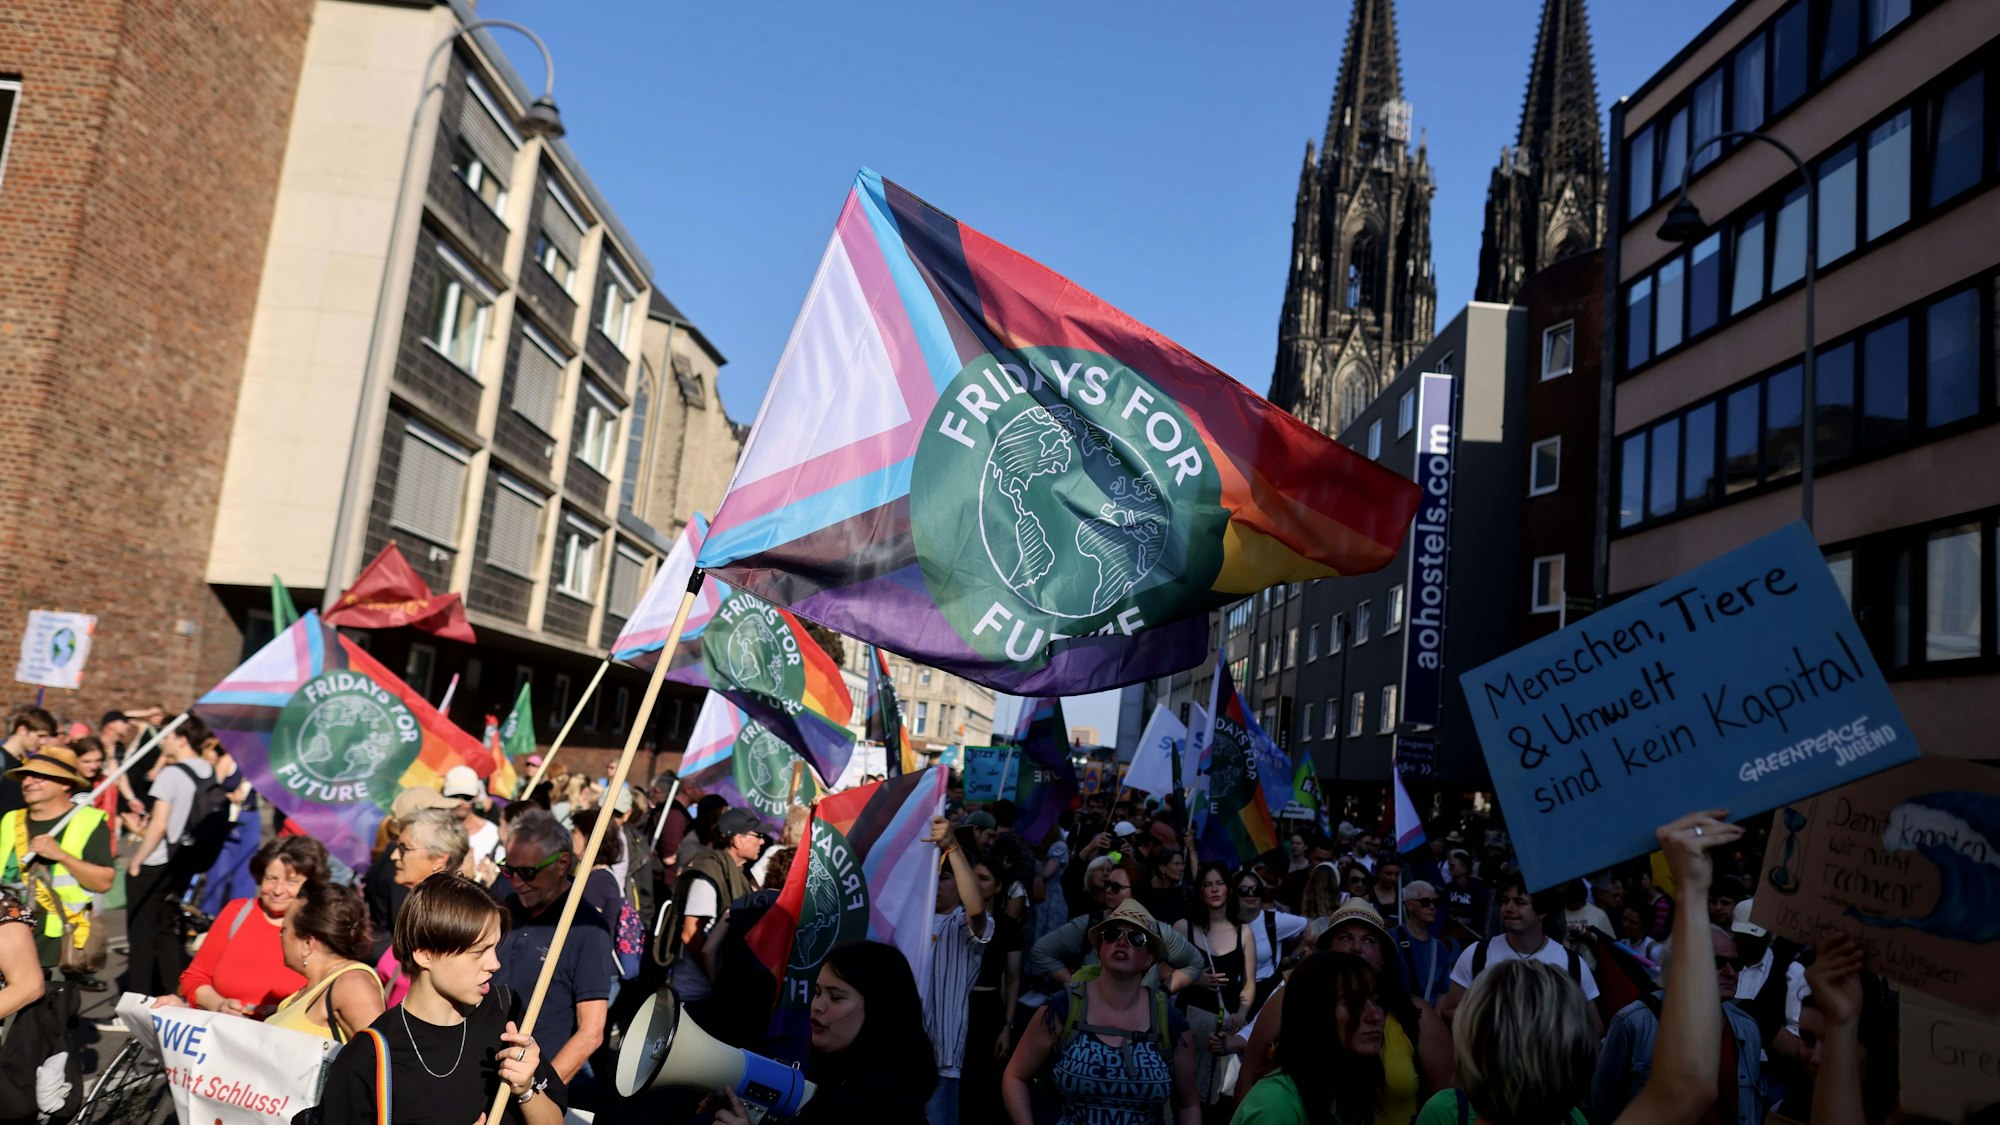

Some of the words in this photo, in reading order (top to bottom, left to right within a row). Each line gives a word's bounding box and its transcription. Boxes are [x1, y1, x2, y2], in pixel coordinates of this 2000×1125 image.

[938, 359, 1109, 449] FRIDAYS
[1120, 385, 1203, 488] FOR
[1411, 423, 1451, 670] aohostels.com
[720, 593, 779, 626] FRIDAYS
[776, 626, 801, 667] FOR
[1484, 619, 1666, 719] Menschen,
[1659, 566, 1798, 633] Tiere
[305, 673, 391, 703] FRIDAYS
[390, 701, 419, 743] FOR
[1507, 725, 1549, 770] &
[1542, 660, 1676, 746] Umwelt
[1533, 751, 1604, 814] sind
[1610, 723, 1698, 777] kein
[1703, 630, 1866, 736] Kapital
[278, 763, 368, 801] FUTURE
[1738, 717, 1869, 784] GREENPEACE
[1834, 723, 1898, 769] JUGEND
[203, 1076, 290, 1117] Schluss!
